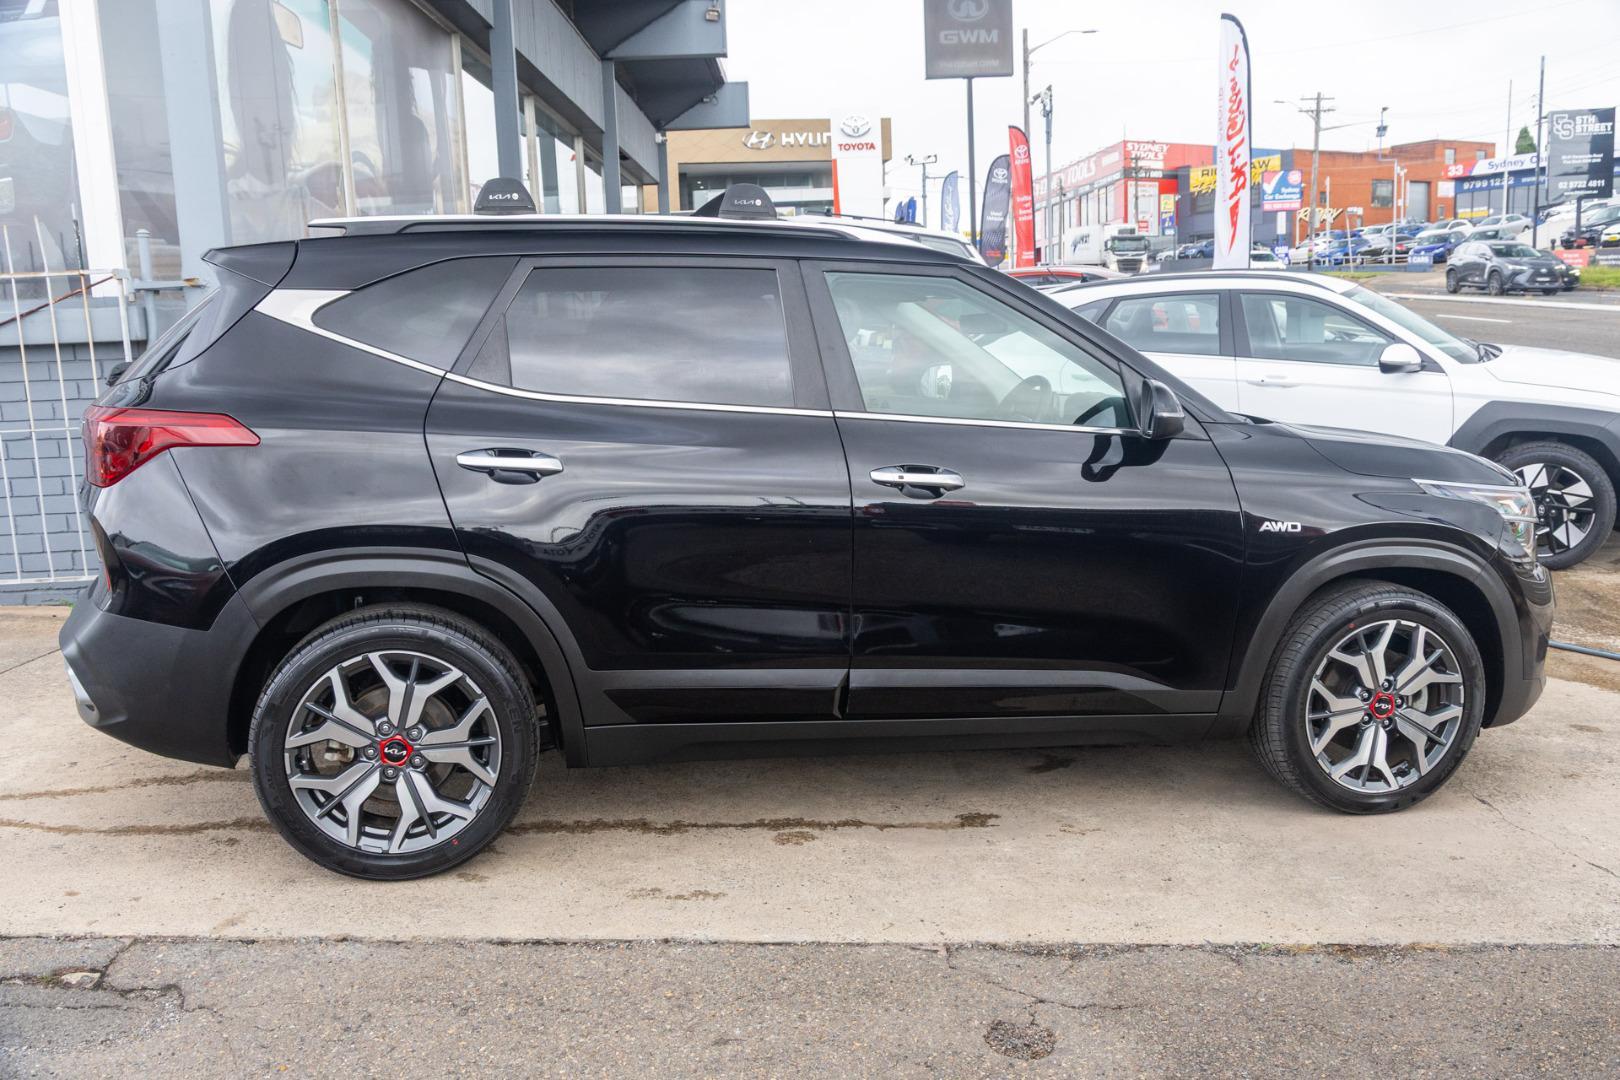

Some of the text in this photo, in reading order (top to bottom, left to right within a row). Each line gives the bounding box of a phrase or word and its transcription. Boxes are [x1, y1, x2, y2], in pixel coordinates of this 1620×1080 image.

[939, 29, 999, 44] GWM
[1575, 122, 1613, 133] STREET
[838, 142, 876, 151] TOYOTA
[1126, 143, 1169, 152] SYDNEY
[1447, 164, 1463, 177] 33
[1488, 159, 1525, 171] Sydney
[1259, 521, 1302, 533] AWD
[384, 746, 407, 756] KIA
